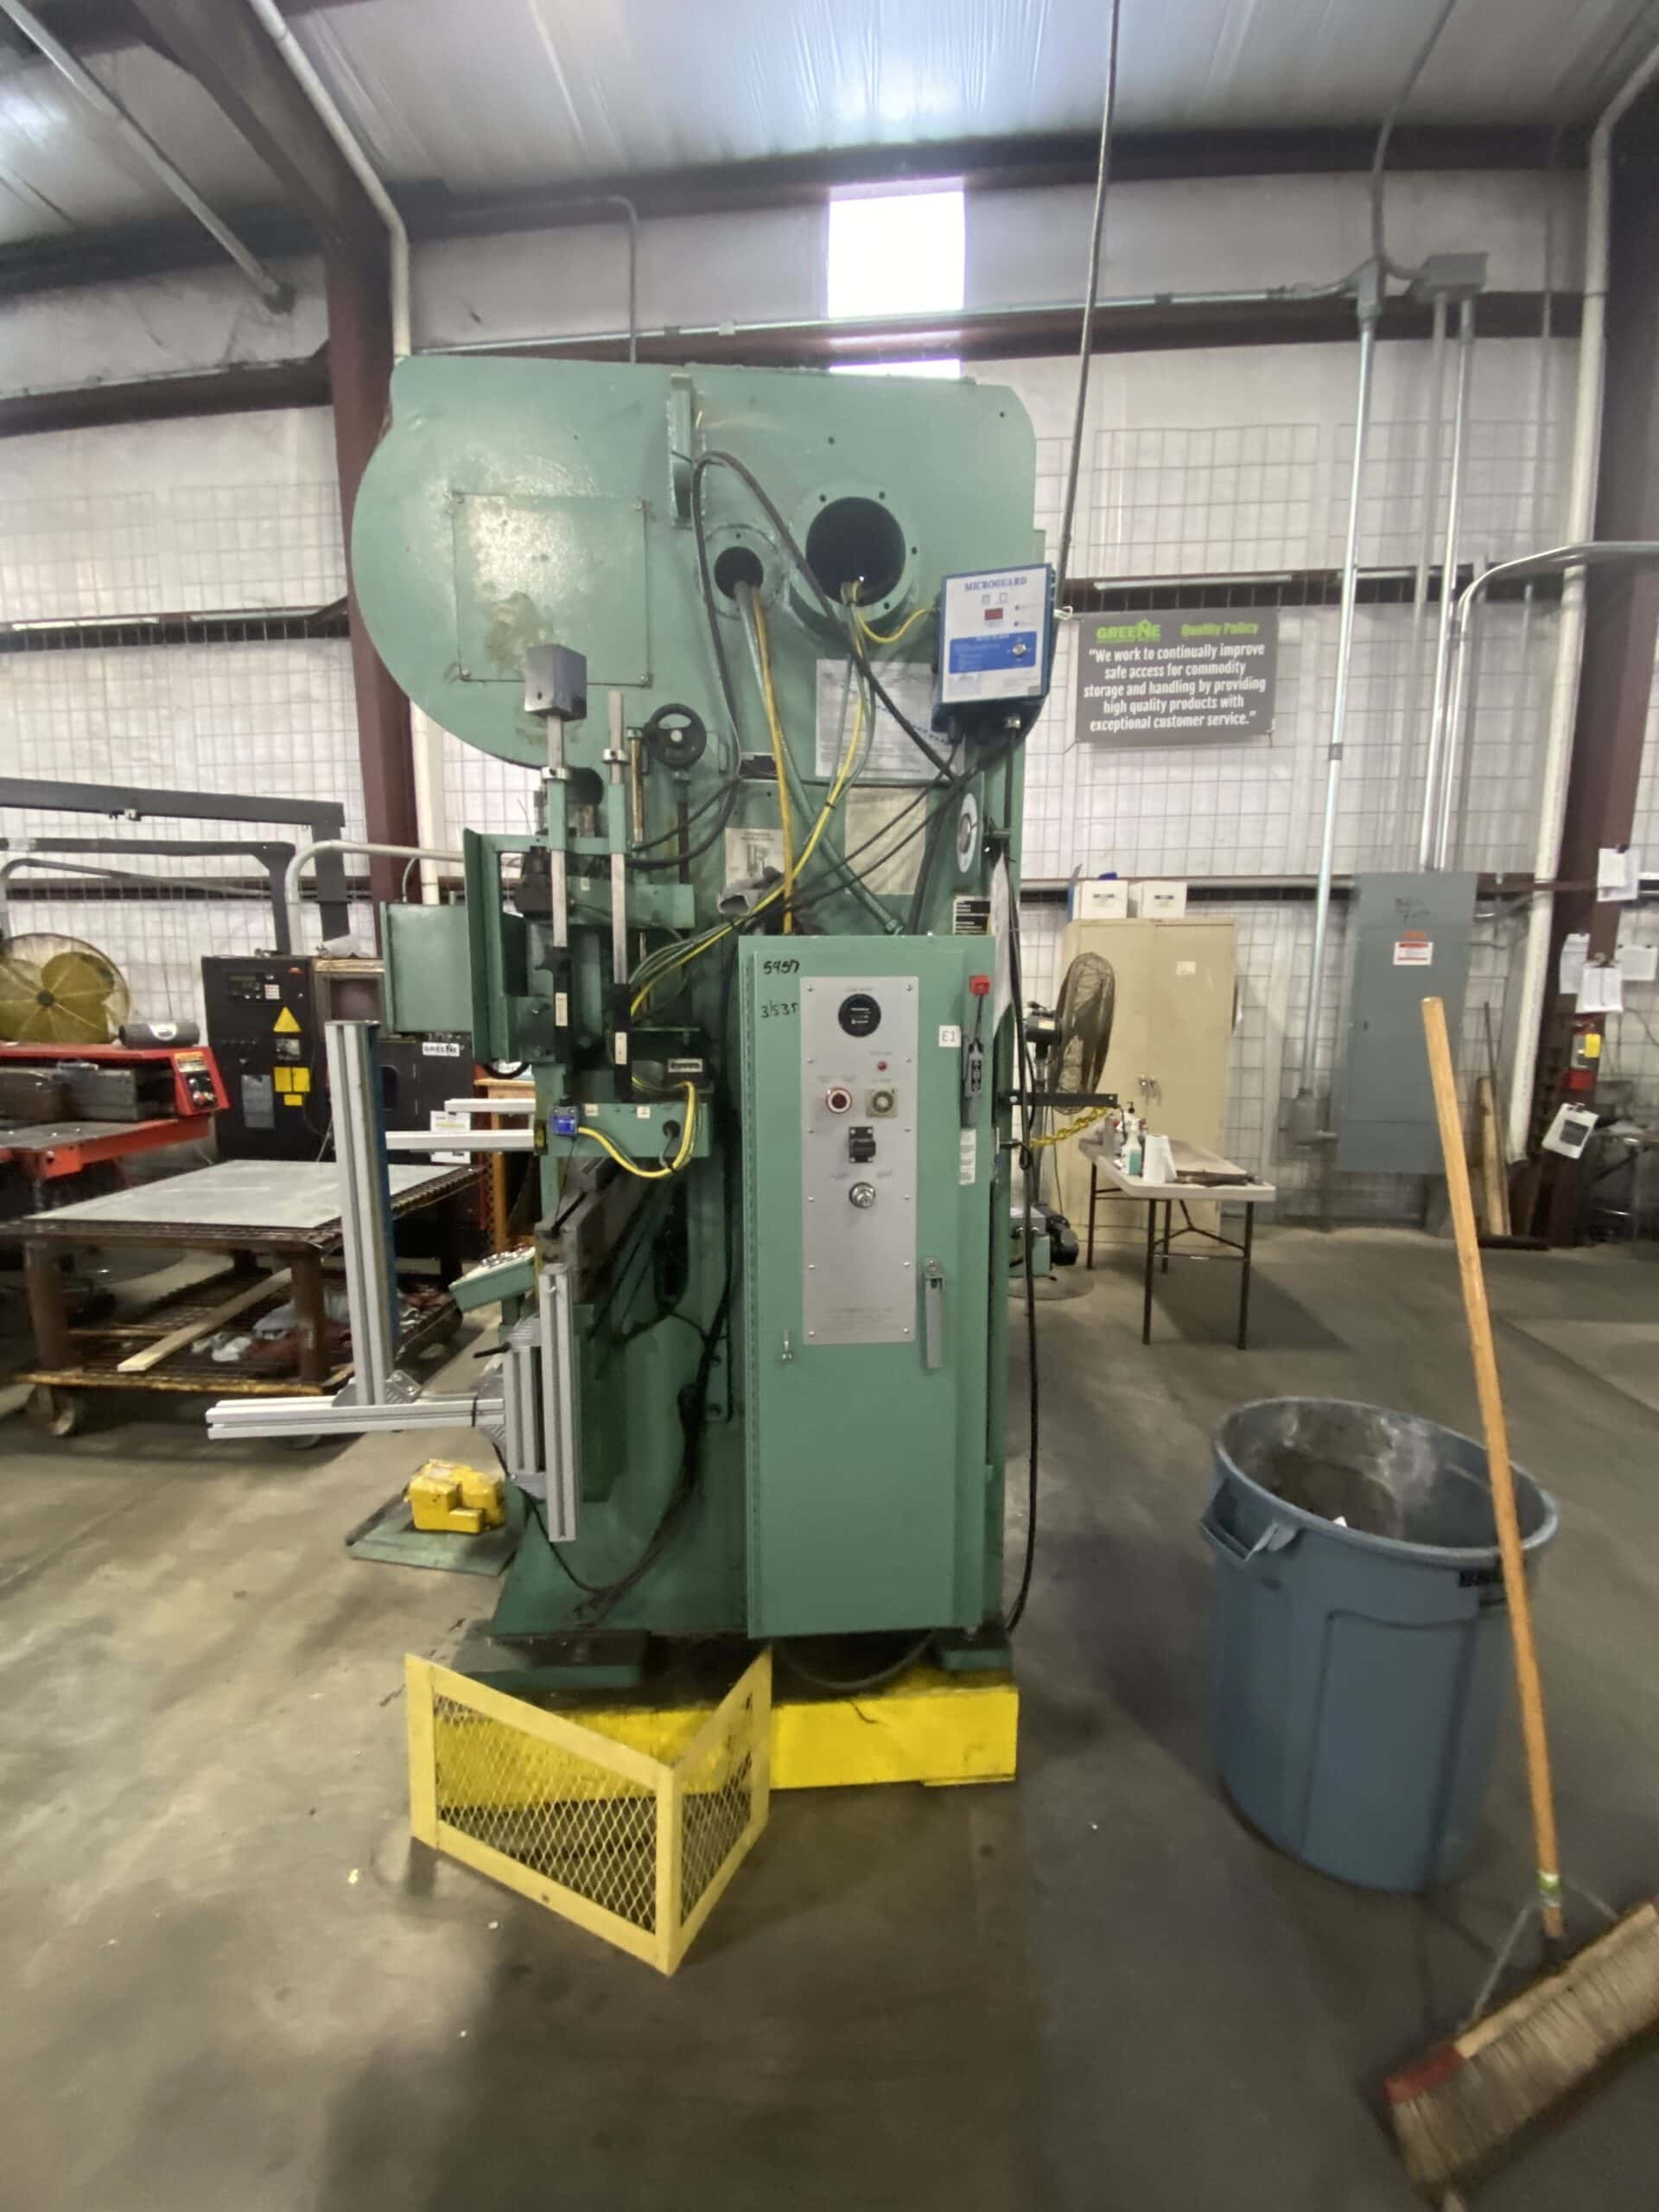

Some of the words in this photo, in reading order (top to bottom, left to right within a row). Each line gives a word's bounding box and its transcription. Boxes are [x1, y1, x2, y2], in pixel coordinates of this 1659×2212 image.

[965, 576, 1027, 591] MICROGUARD
[1115, 647, 1141, 662] work
[1144, 647, 1155, 660] to
[1157, 644, 1217, 660] continually
[1220, 643, 1265, 658] improve
[1105, 664, 1127, 679] safe
[1129, 666, 1164, 678] access
[1167, 663, 1183, 677] for
[1185, 659, 1246, 677] commodity
[1084, 684, 1122, 699] storage
[1127, 681, 1147, 696] and
[1149, 678, 1196, 695] handling
[1199, 678, 1211, 694] by
[1214, 677, 1266, 692] providing
[1103, 700, 1127, 715] high
[1129, 698, 1166, 715] quality
[1169, 696, 1217, 712] products
[1220, 694, 1244, 709] with
[1090, 715, 1151, 733] exceptional
[1154, 714, 1203, 728] customer
[942, 1030, 956, 1043] E1
